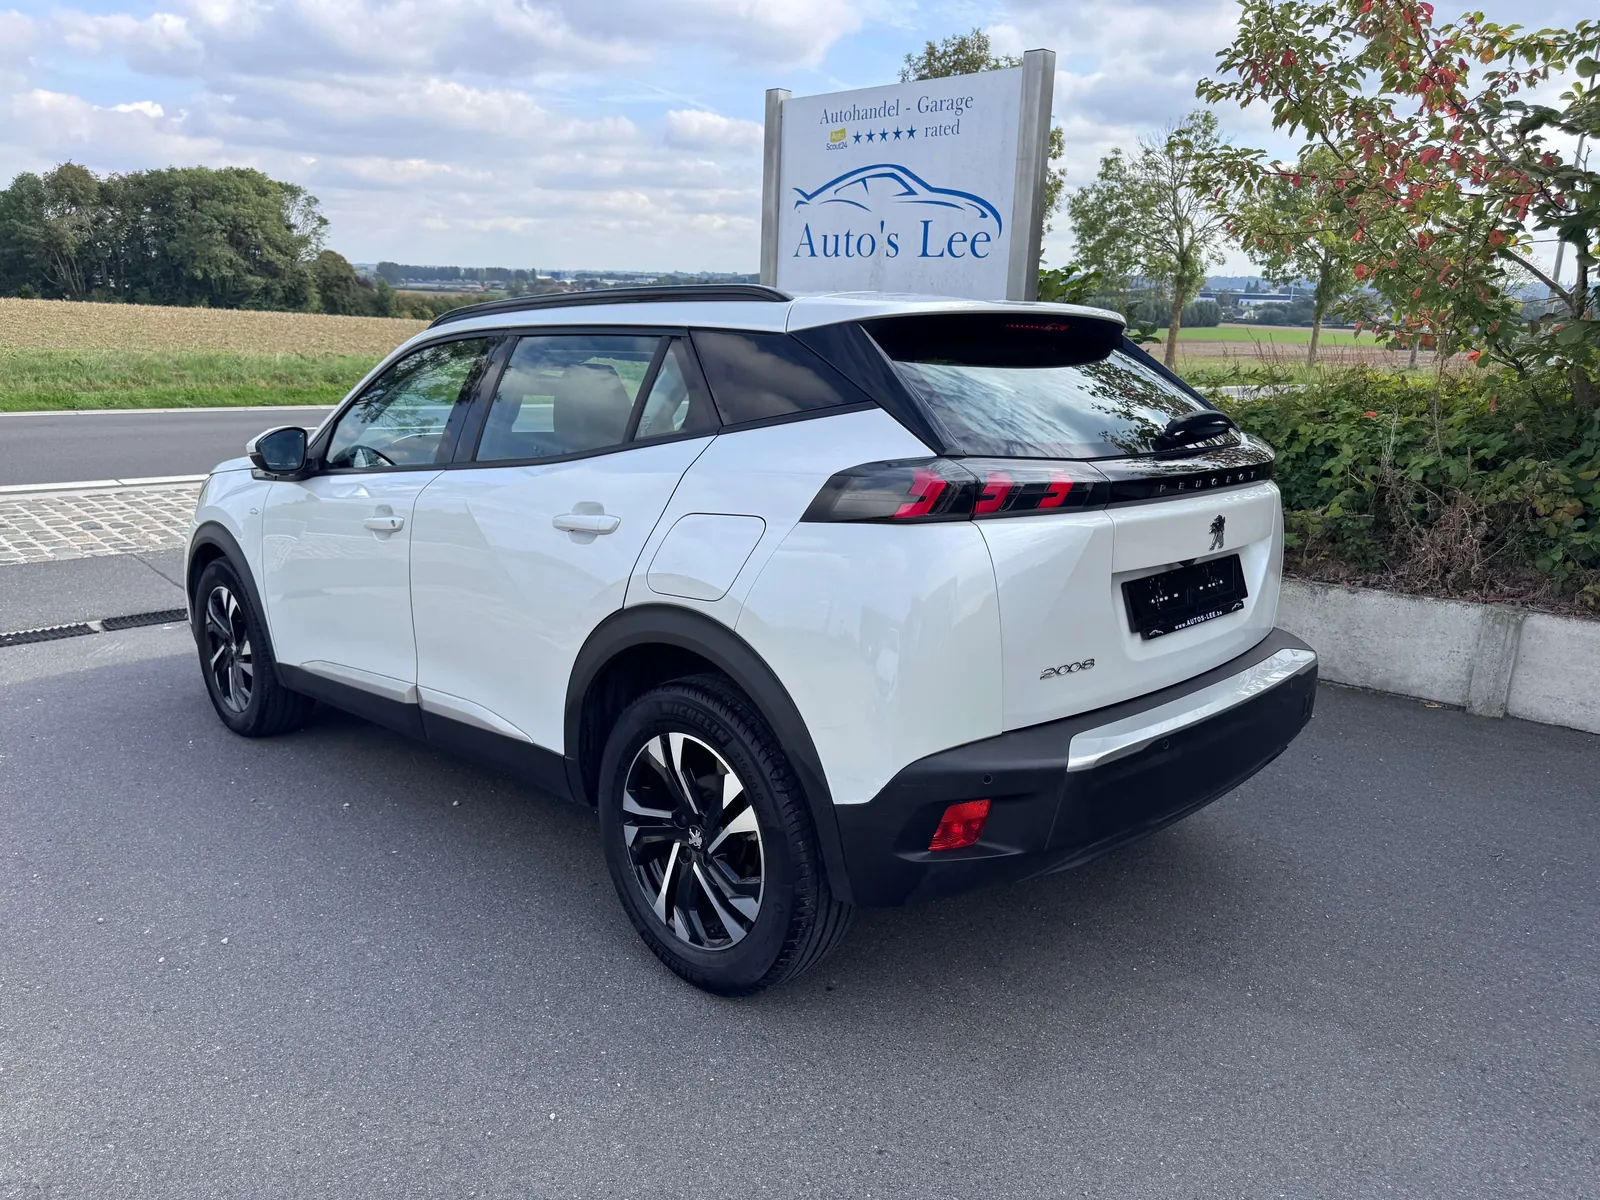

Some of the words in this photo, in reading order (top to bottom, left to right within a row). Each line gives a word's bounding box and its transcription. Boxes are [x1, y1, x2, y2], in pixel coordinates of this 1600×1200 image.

[820, 99, 900, 124] Autohandel
[917, 95, 974, 116] Garage
[924, 119, 961, 138] rated
[826, 142, 848, 151] Scout24
[793, 220, 899, 258] Auto's
[917, 220, 992, 258] Lee
[1159, 471, 1256, 493] PEUGEOT
[1040, 658, 1095, 680] 2008
[661, 702, 732, 745] MICHELIN
